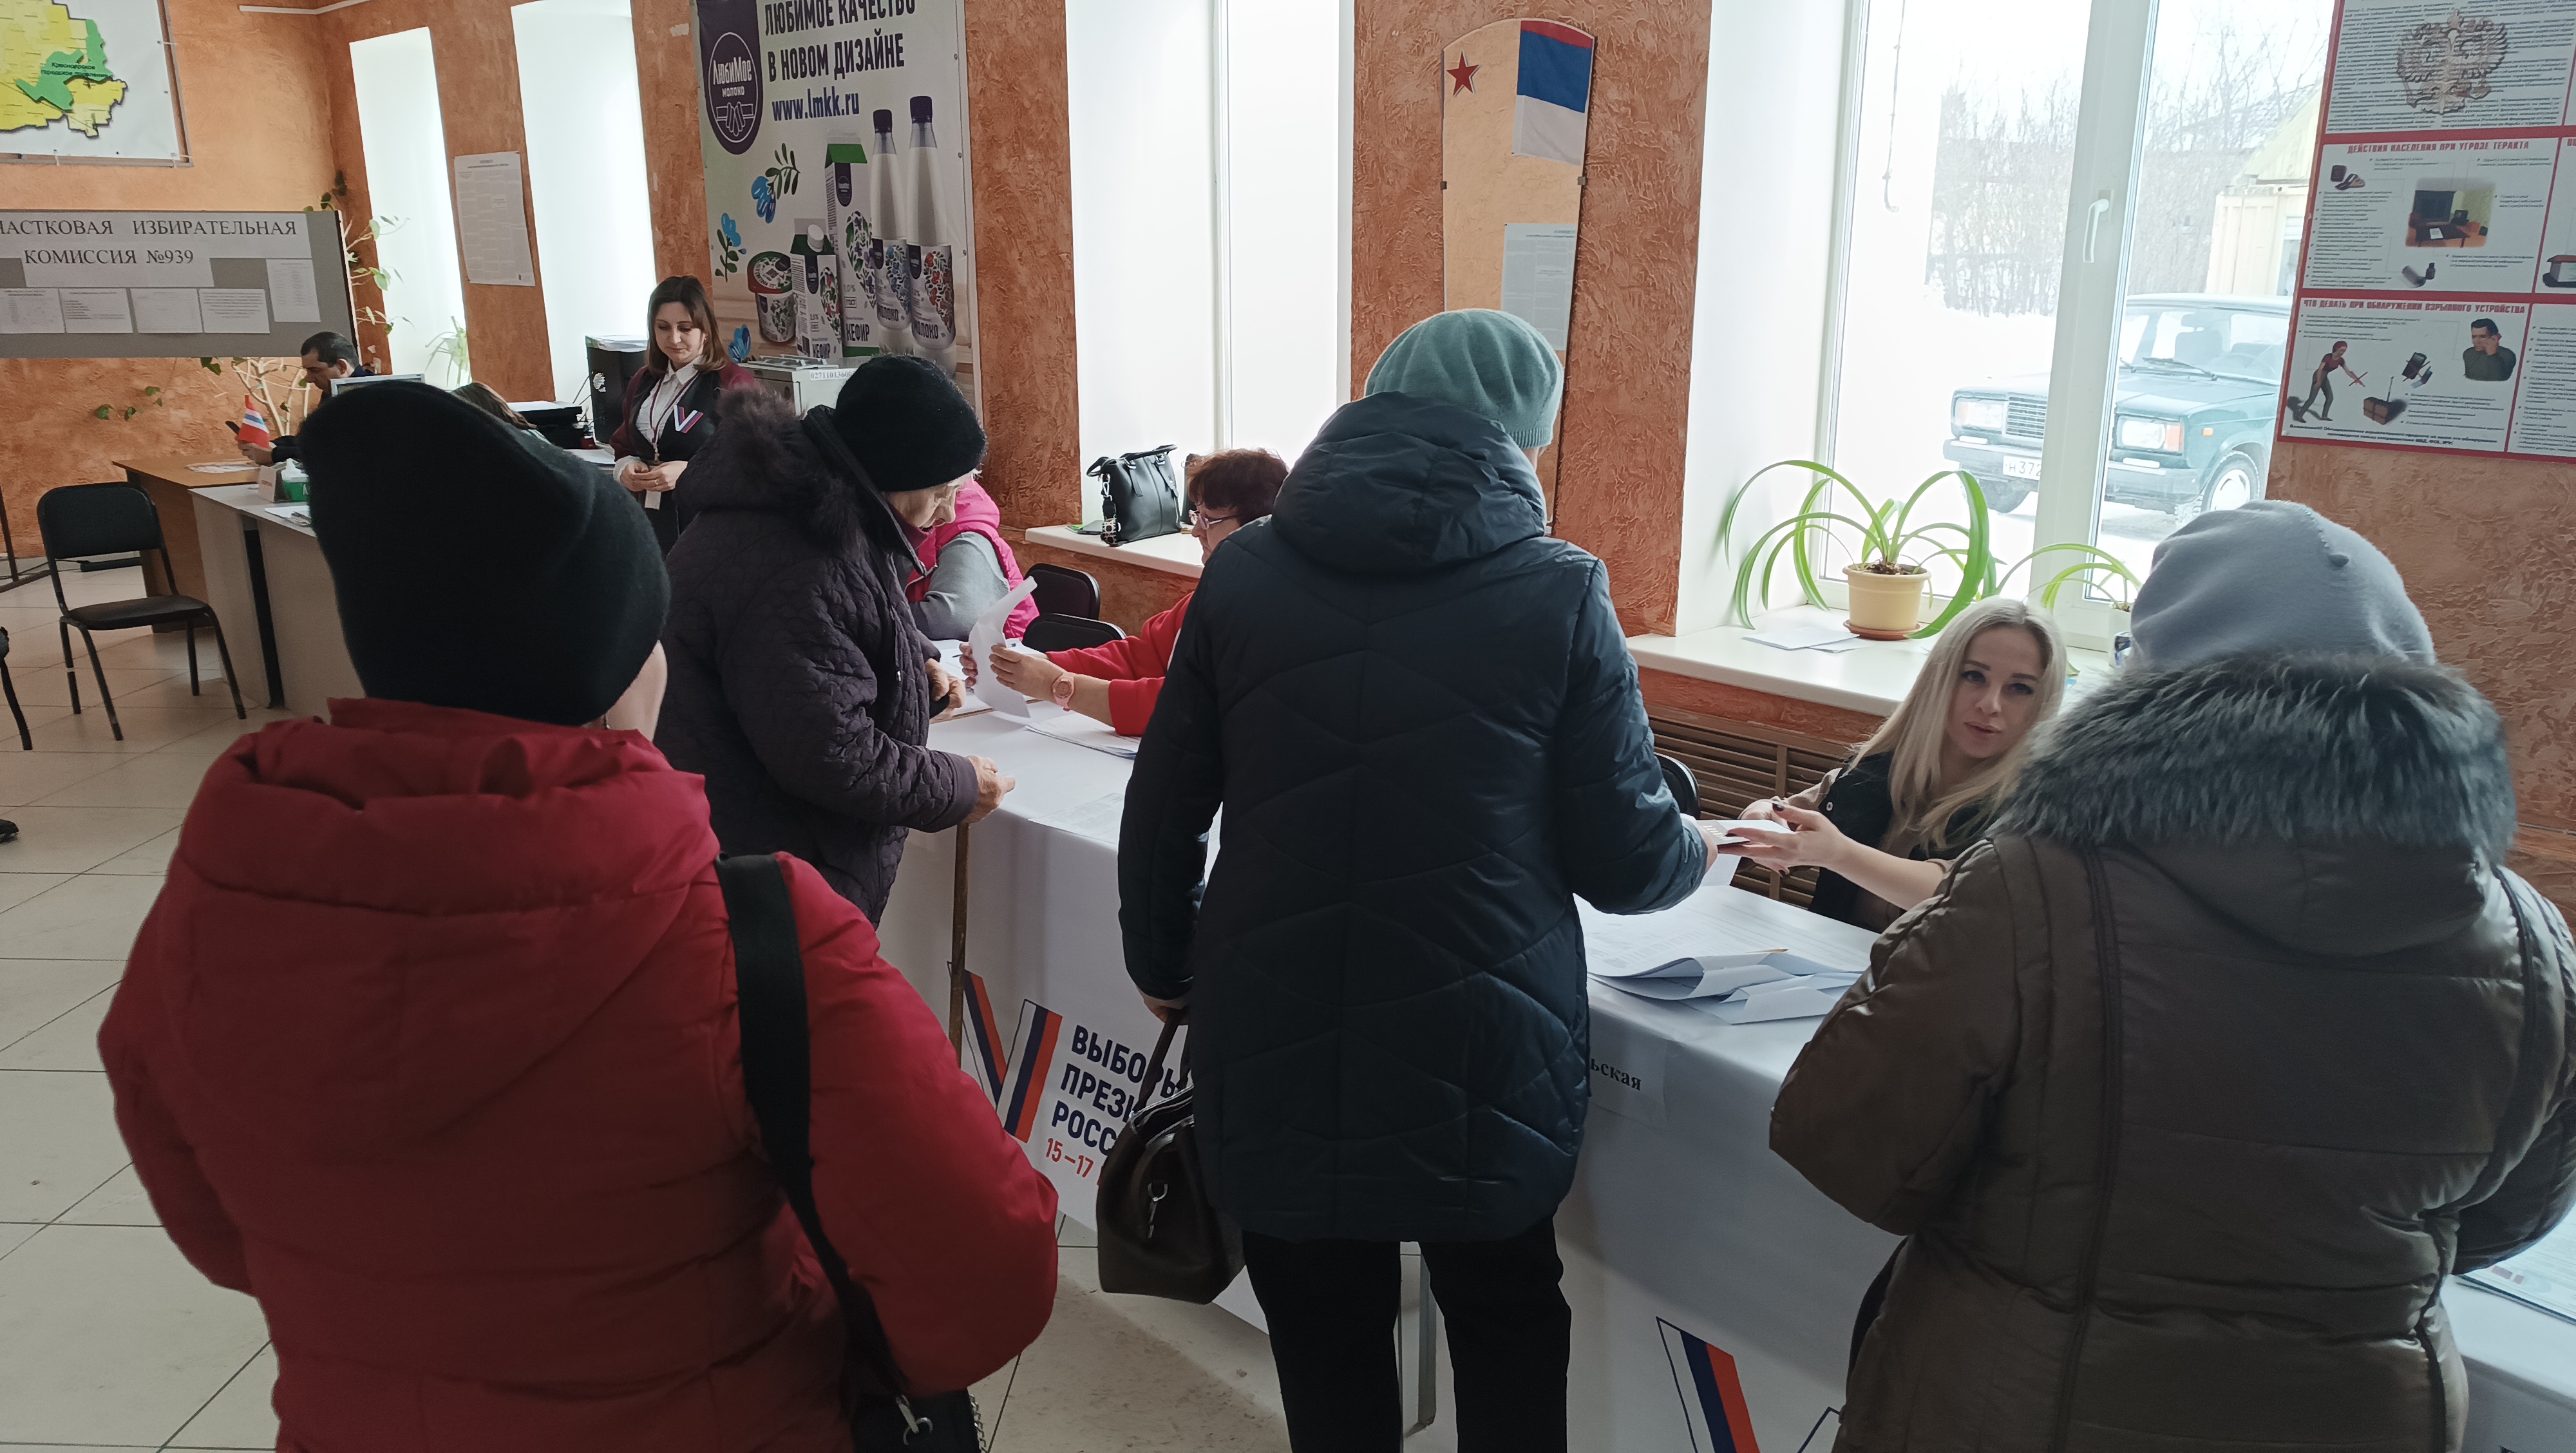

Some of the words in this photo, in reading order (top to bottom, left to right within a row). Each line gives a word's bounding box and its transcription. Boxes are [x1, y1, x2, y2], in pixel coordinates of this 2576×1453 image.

[764, 0, 834, 36] ЛЮБИМОЕ
[767, 51, 777, 82] В
[780, 44, 829, 80] НОВОМ
[833, 28, 905, 81] ДИЗАЙНЕ
[712, 56, 752, 85] ЛюбиМое
[772, 86, 860, 121] www.lmkk.ru
[2347, 143, 2388, 154] ДЕЙСТВИЯ
[2391, 143, 2437, 152] НАСЕЛЕНИЯ
[2439, 142, 2456, 151] ПРИ
[2459, 142, 2490, 151] УГРОЗЕ
[2494, 141, 2529, 150] ТЕРАКТА
[132, 220, 298, 235] ИЗБИРАТЕЛЬНАЯ
[23, 249, 138, 265] КОМИССИЯ
[146, 249, 194, 265] №939
[2304, 299, 2317, 308] ЧТО
[2319, 299, 2347, 309] ДЕЛАТЬ
[2349, 300, 2364, 309] ПРИ
[2367, 301, 2423, 310] ОБНАРУЖЕНИИ
[2425, 303, 2472, 312] ВЗРЫВНОГО
[2475, 304, 2526, 314] УСТРОЙСТВА
[846, 323, 870, 341] КЕФИР
